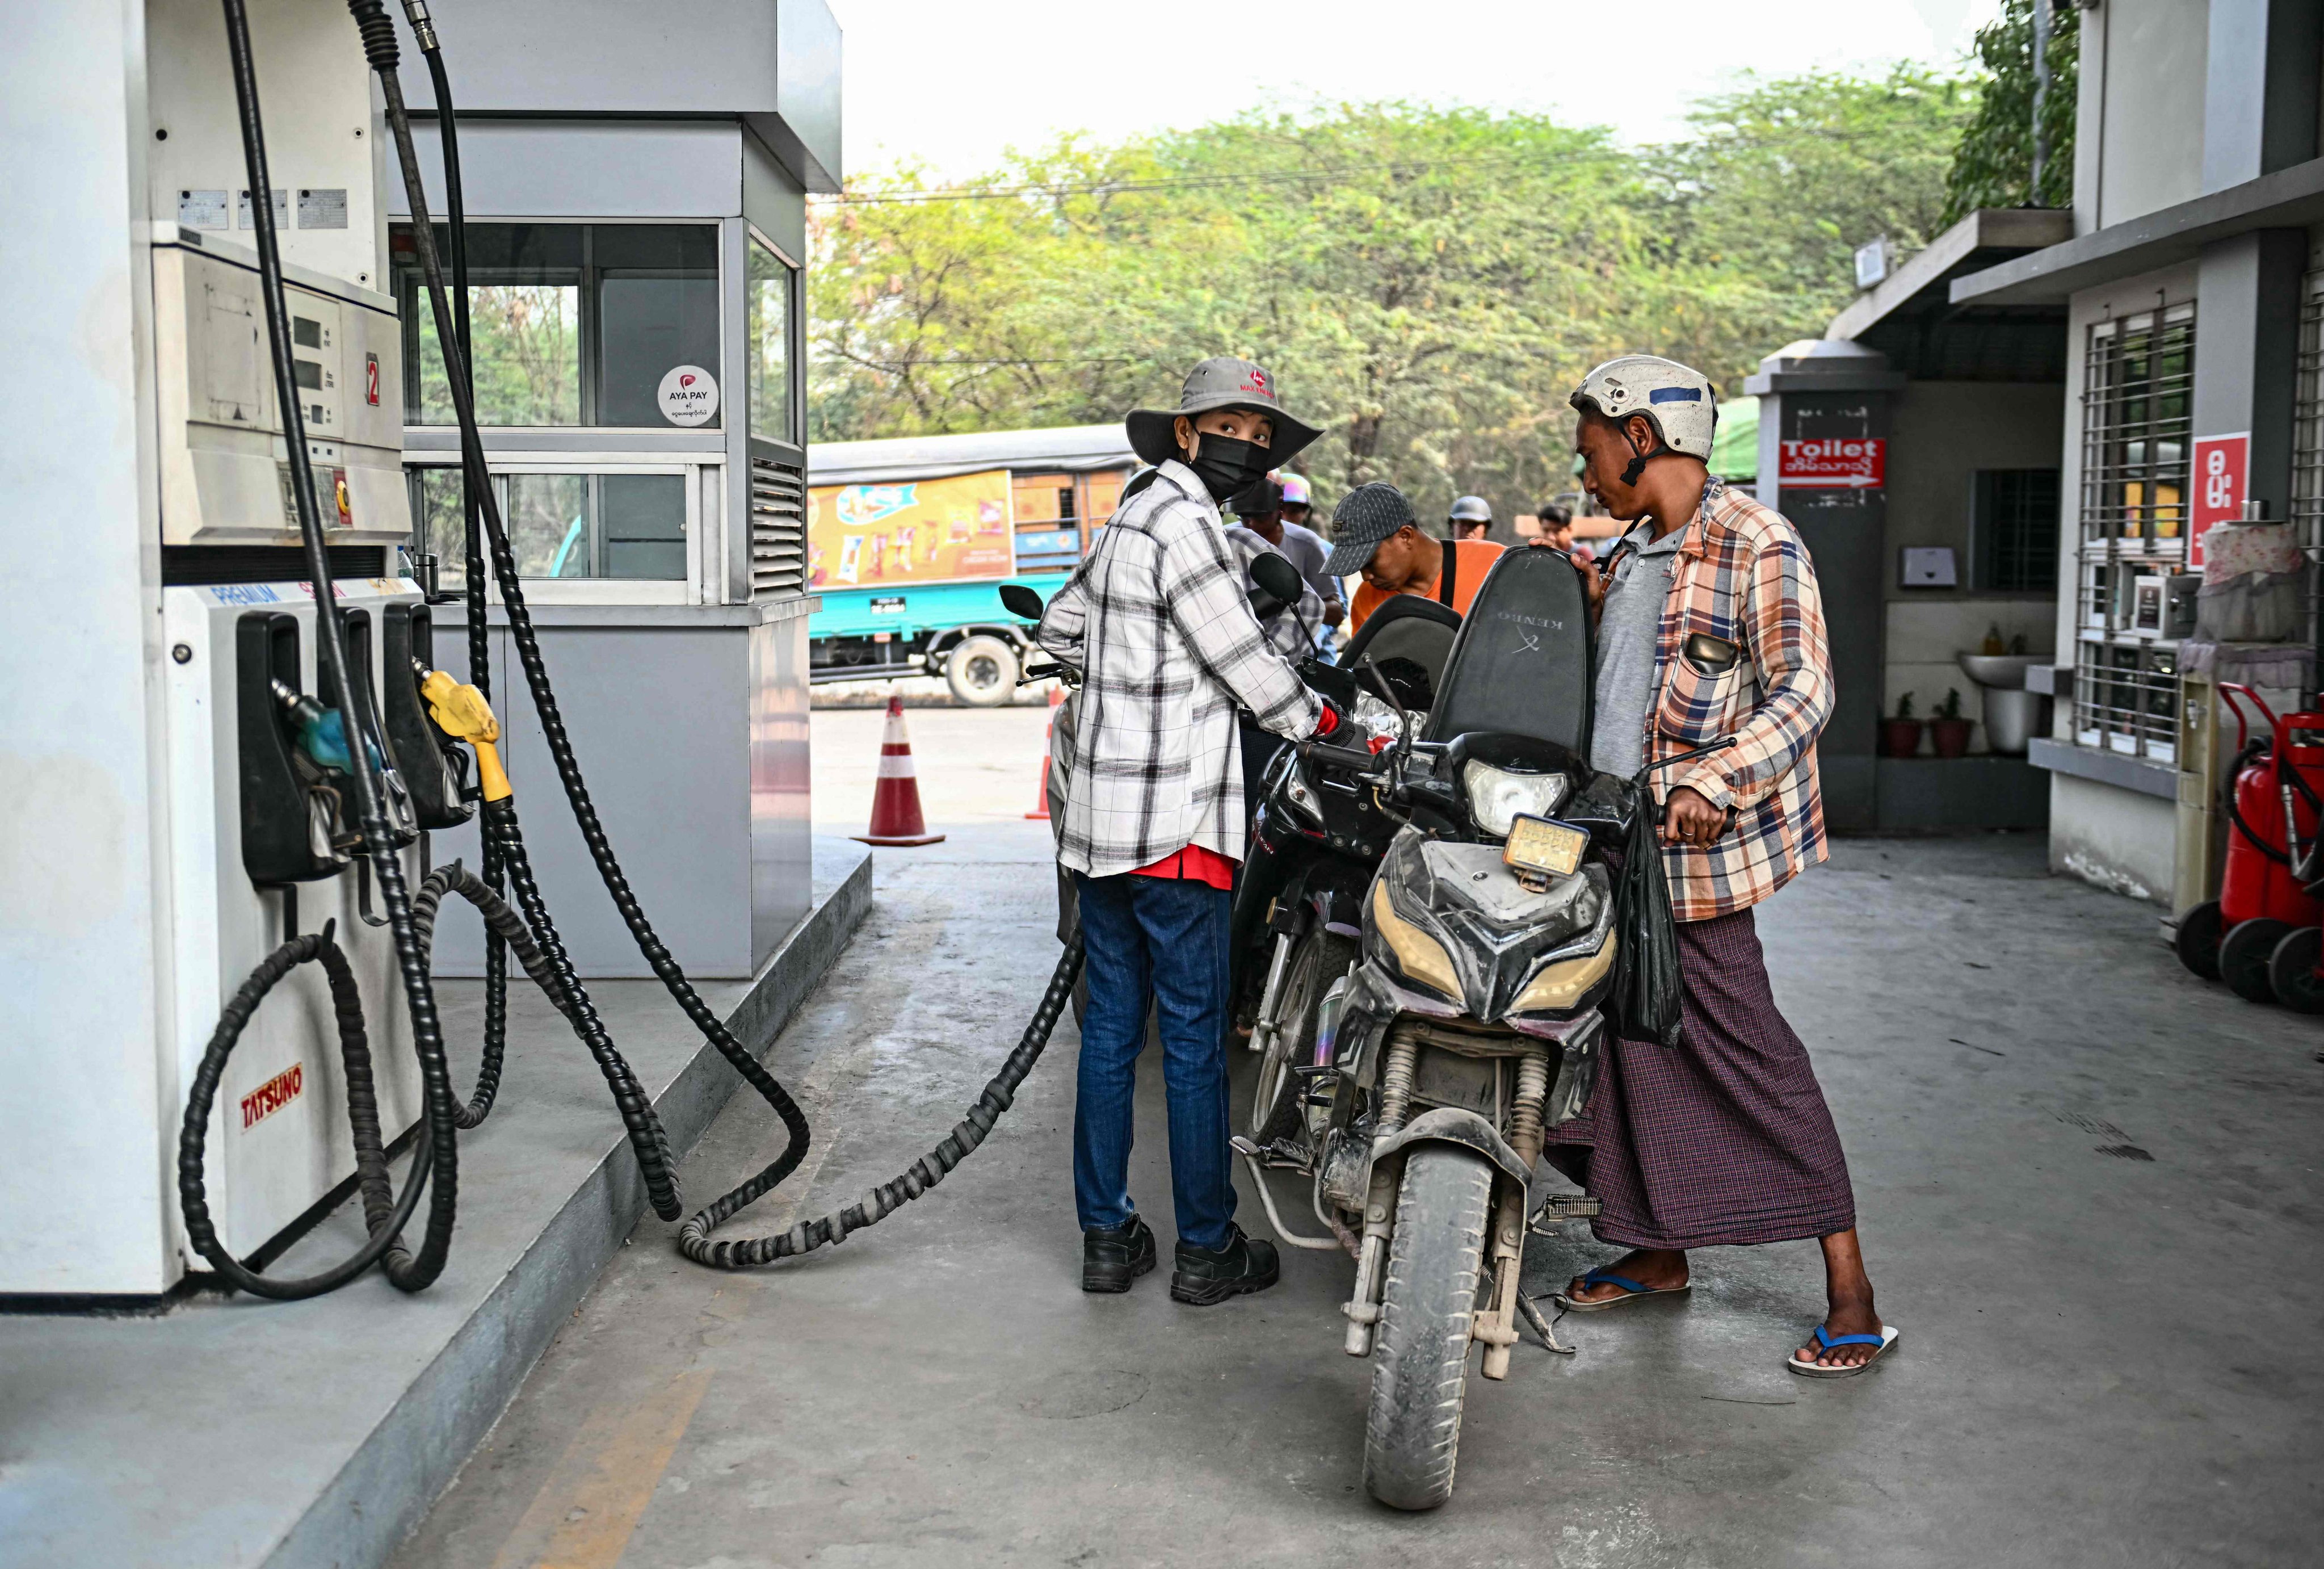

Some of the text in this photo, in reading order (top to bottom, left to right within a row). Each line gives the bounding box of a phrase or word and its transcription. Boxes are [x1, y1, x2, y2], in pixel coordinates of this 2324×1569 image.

[368, 362, 379, 404] 2
[1256, 387, 1275, 400] ENERGY
[1781, 439, 1877, 457] Toilet
[210, 584, 281, 605] PREMIUM
[241, 1067, 302, 1129] TATSUNO
